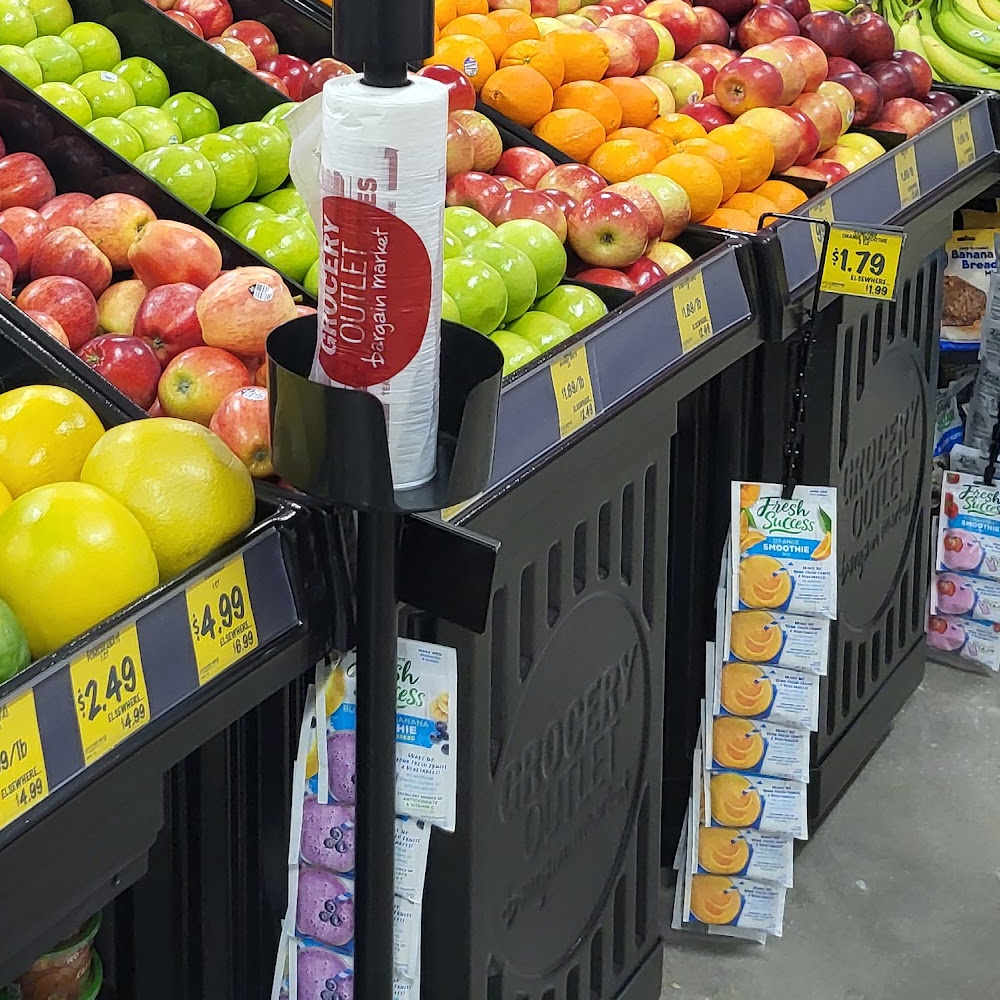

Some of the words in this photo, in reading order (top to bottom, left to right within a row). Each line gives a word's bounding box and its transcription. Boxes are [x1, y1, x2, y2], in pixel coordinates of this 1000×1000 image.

[372, 226, 390, 290] market
[832, 247, 886, 276] $1.79
[952, 250, 994, 259] Banana
[320, 218, 341, 357] GROCERY
[340, 244, 368, 344] OUTLET
[866, 284, 888, 296] $1.99
[361, 293, 395, 368] bargain
[841, 395, 921, 505] GROCERY
[757, 496, 810, 517] Fresh
[850, 449, 908, 539] OUTLET
[959, 484, 1000, 504] Fresh
[763, 512, 815, 532] Success
[763, 543, 810, 554] SMOOTHIE
[193, 585, 245, 641] $4.99
[232, 631, 254, 655] $6.99
[78, 656, 137, 721] $2.49
[121, 704, 146, 730] $4.99
[499, 642, 640, 824] GROCERY
[15, 777, 43, 806] $4.99
[522, 717, 621, 860] OUTLET
